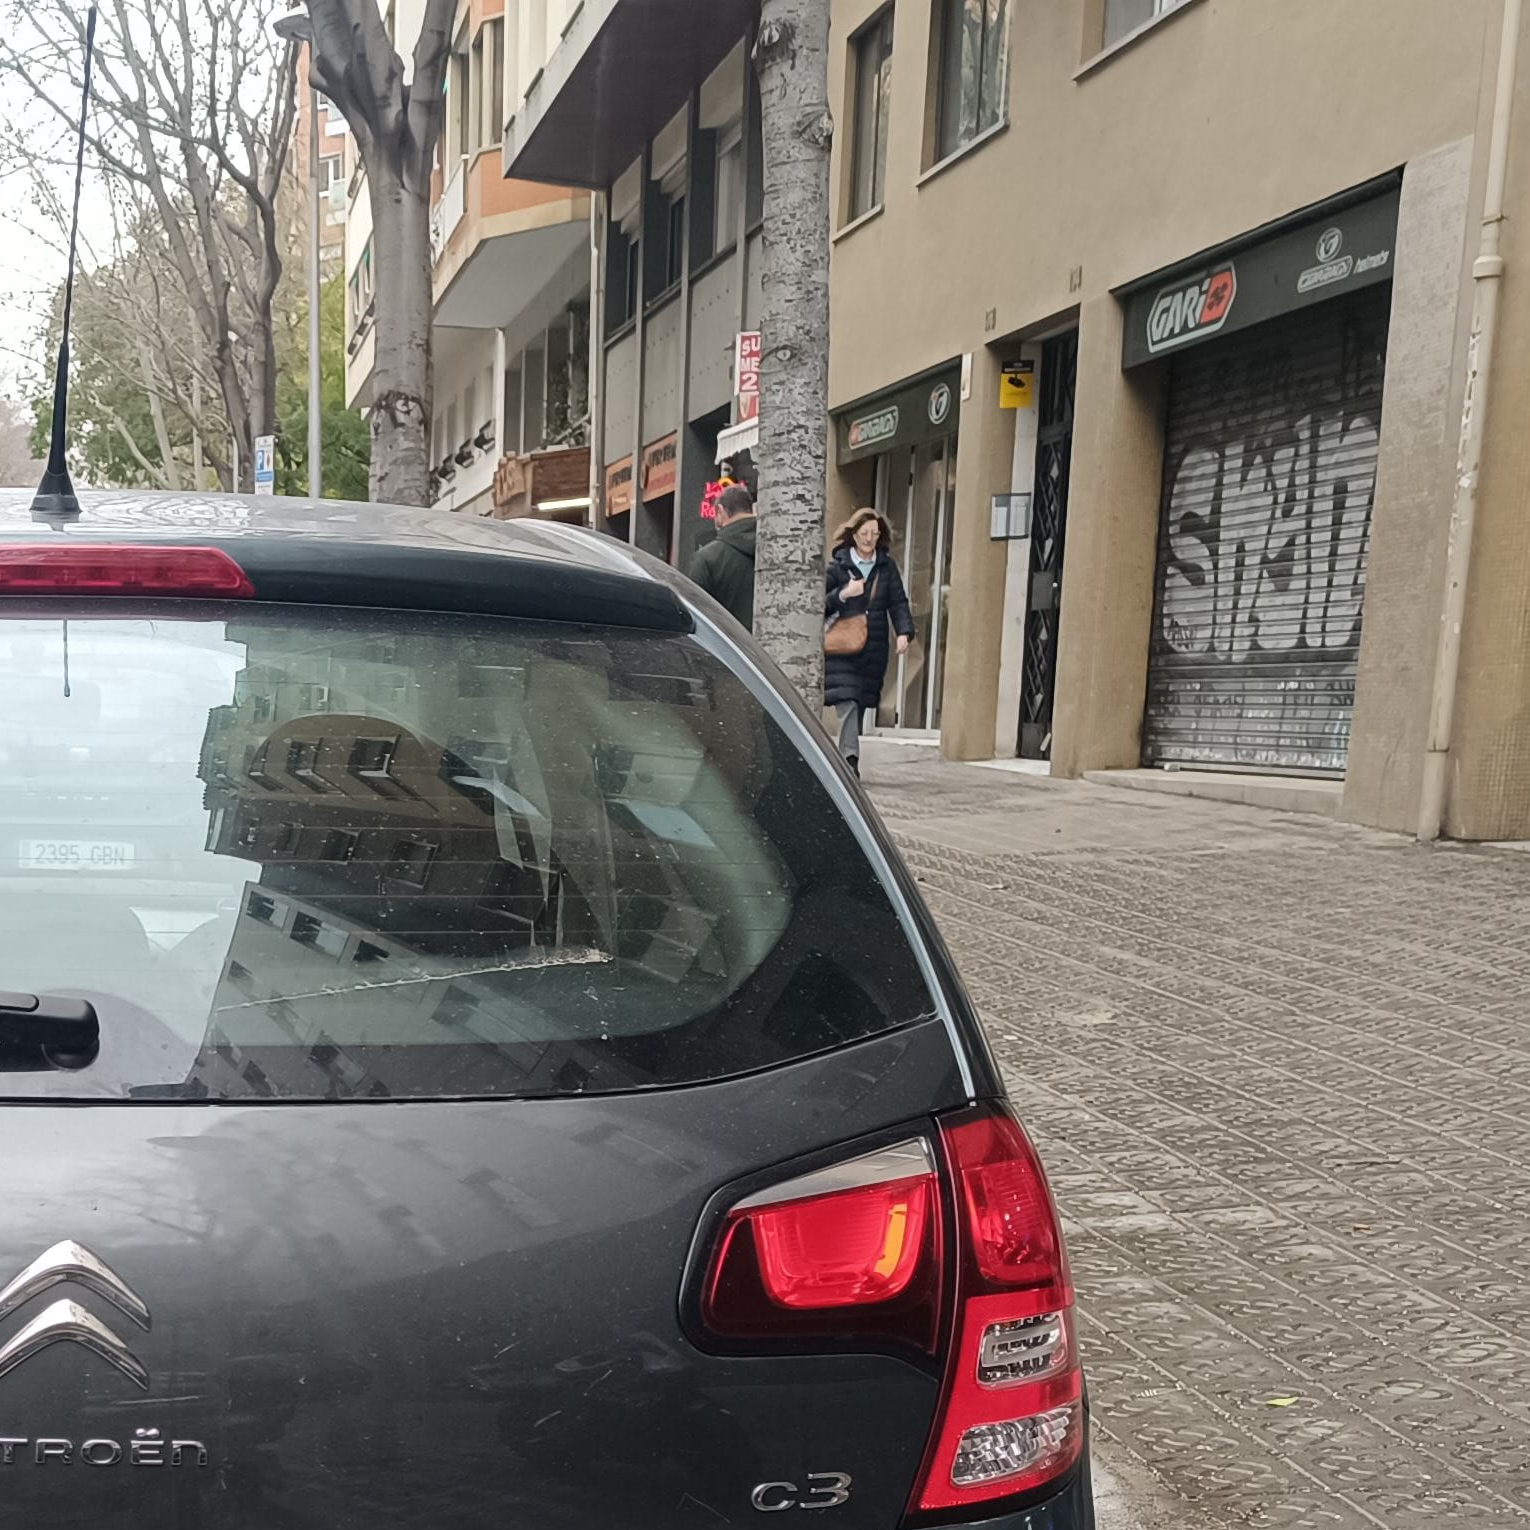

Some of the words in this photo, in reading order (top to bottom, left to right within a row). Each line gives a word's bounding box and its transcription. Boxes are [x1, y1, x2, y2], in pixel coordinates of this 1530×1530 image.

[741, 336, 761, 355] SU
[740, 357, 760, 372] ME
[741, 374, 758, 391] 2
[34, 843, 80, 865] 2395
[90, 845, 125, 866] GBN
[751, 1471, 852, 1511] C3
